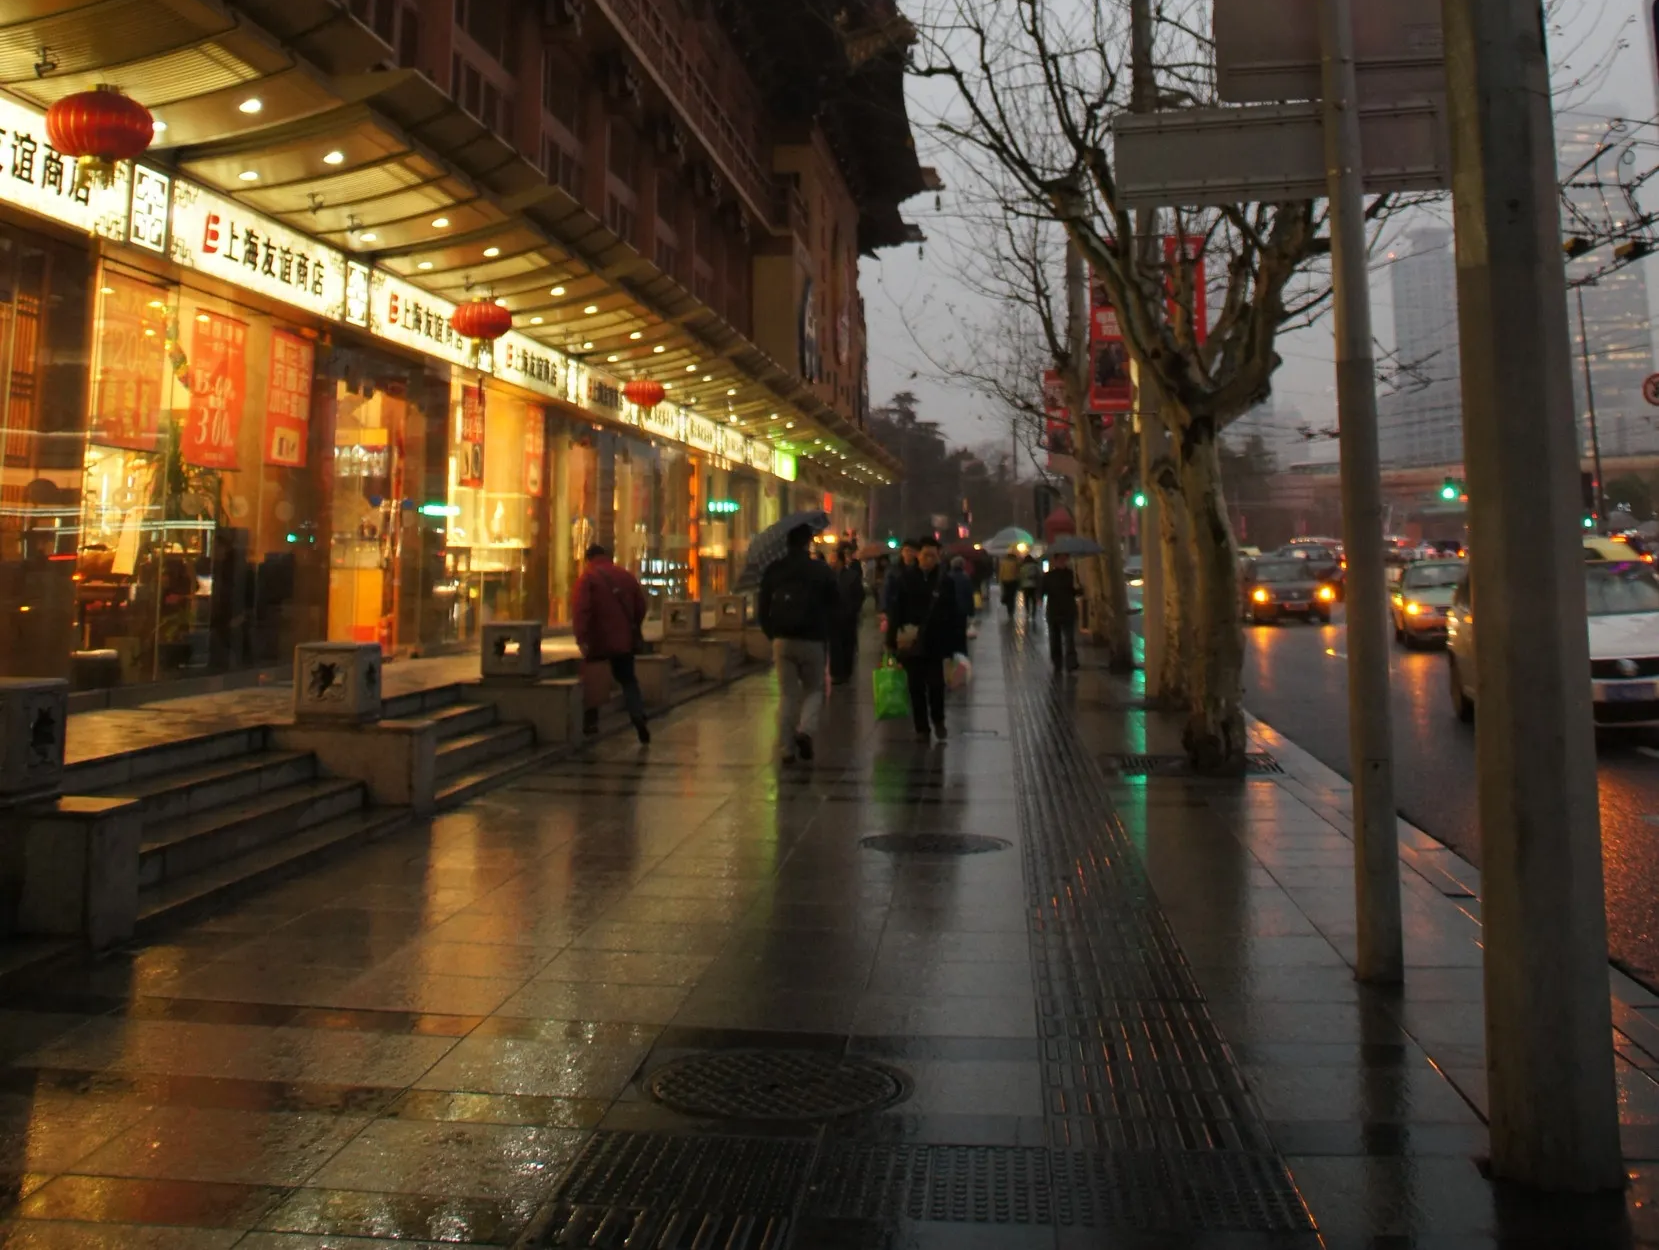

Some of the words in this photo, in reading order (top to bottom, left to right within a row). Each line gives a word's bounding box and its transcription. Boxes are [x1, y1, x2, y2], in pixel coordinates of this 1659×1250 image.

[0, 129, 91, 206] 谊商店
[223, 220, 325, 298] 上海友谊商店
